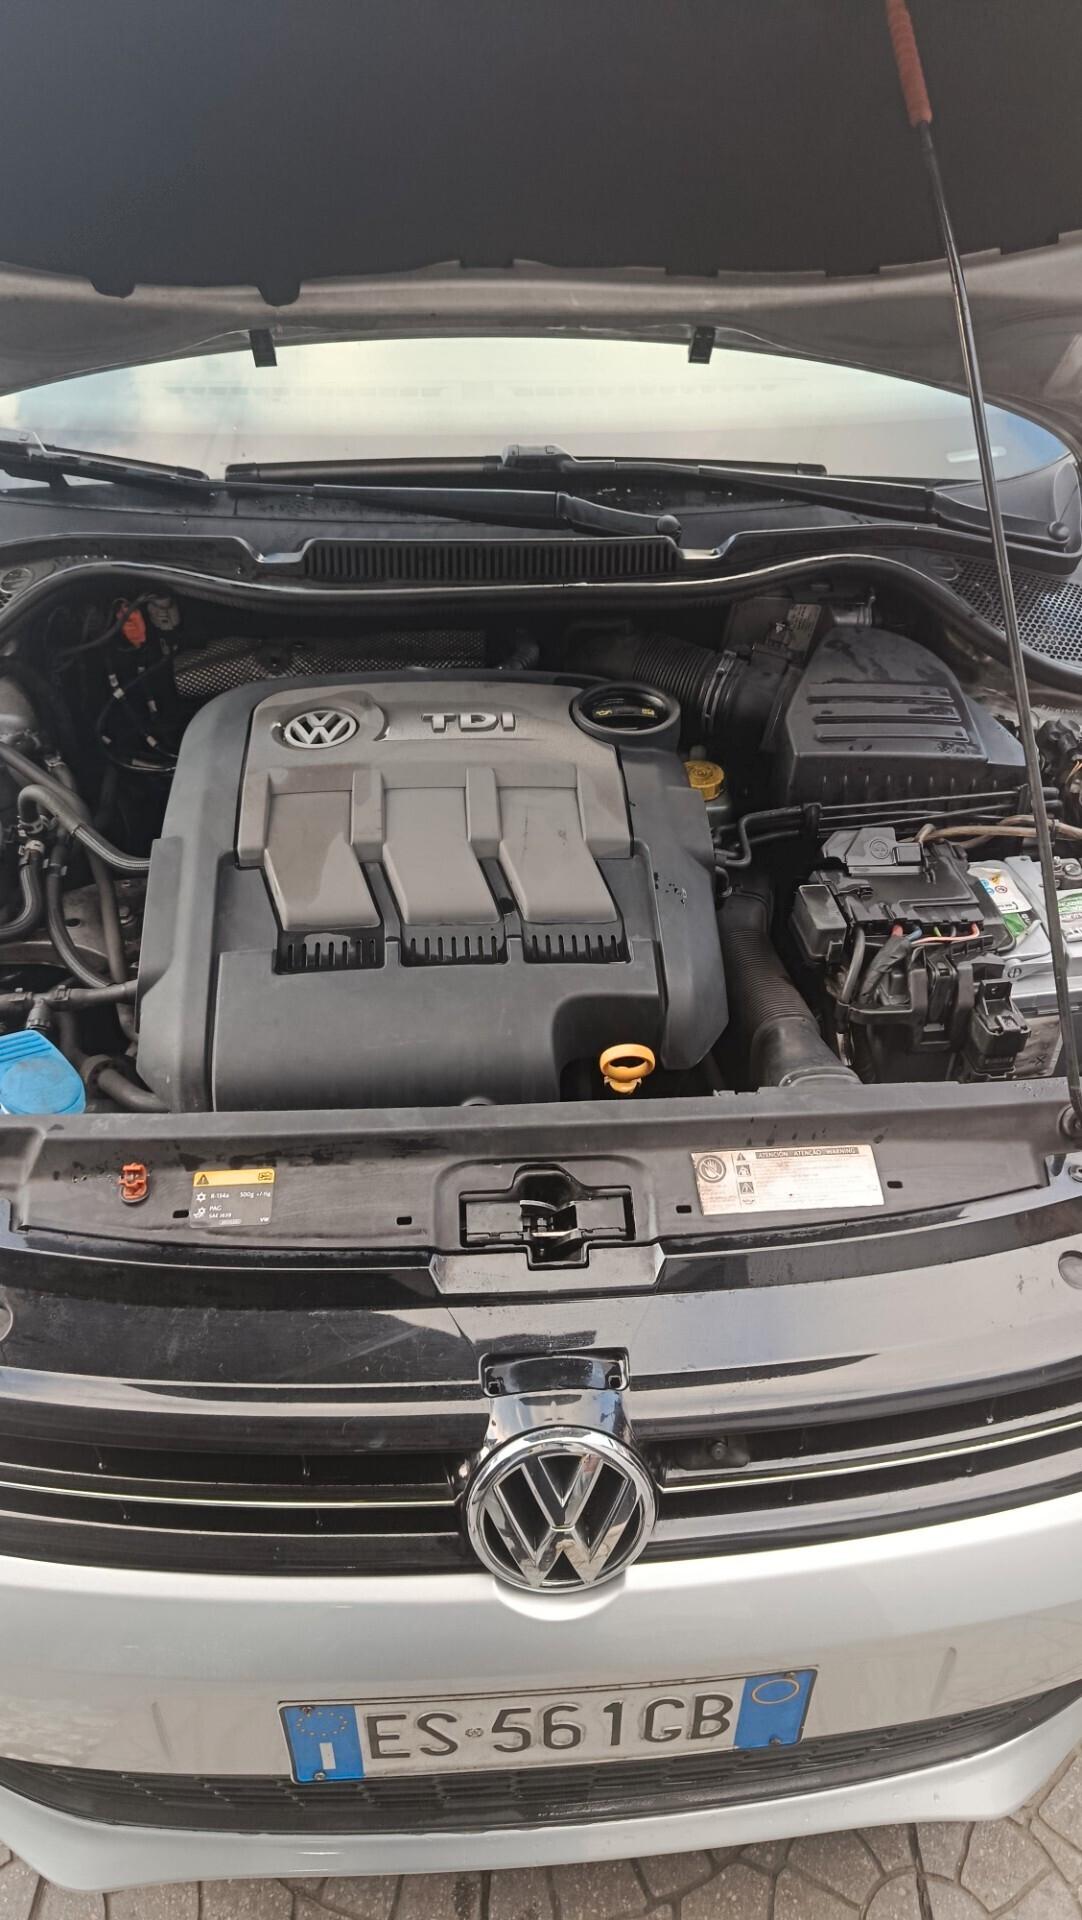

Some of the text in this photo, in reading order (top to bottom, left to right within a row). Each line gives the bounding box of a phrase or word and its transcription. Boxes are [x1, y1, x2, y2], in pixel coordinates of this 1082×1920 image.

[284, 710, 357, 749] VW
[421, 712, 516, 732] TDI
[467, 1426, 656, 1594] VW
[365, 1712, 459, 1760] ES
[319, 1742, 336, 1770] I
